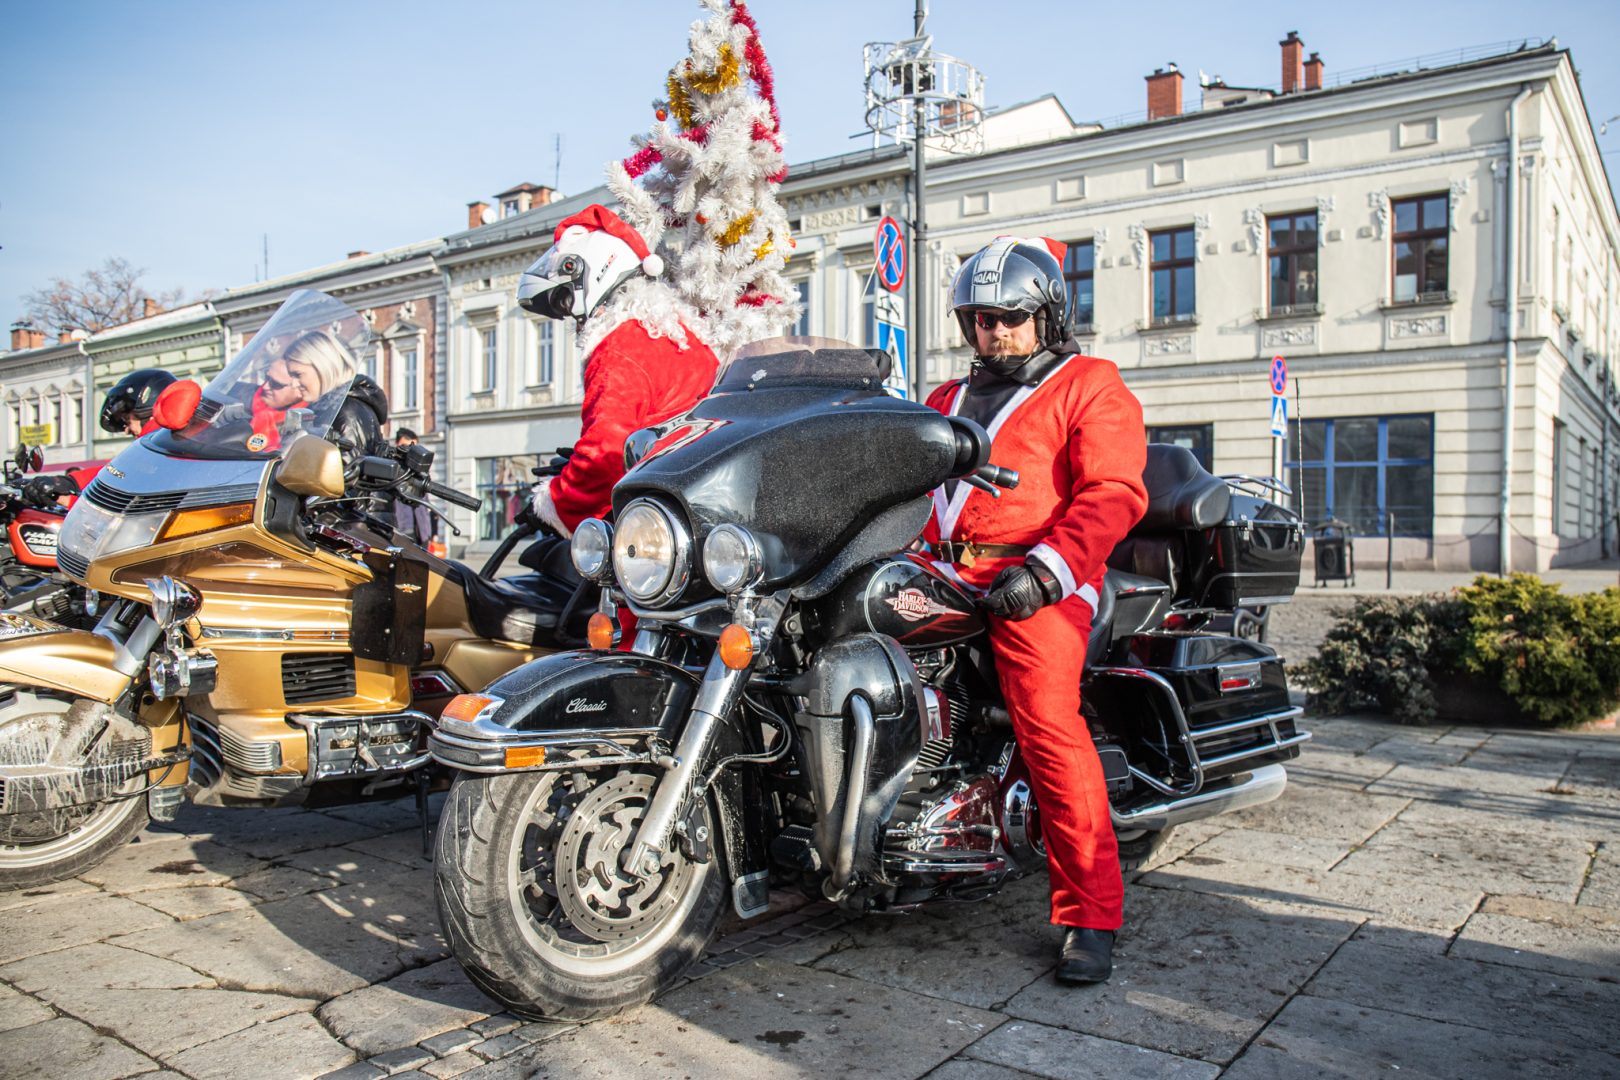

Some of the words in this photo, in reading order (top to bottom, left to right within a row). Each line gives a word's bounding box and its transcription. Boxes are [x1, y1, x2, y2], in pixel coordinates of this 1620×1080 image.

[973, 271, 999, 284] NOLAN
[893, 600, 929, 613] DAVIDSON
[566, 698, 607, 713] Classic
